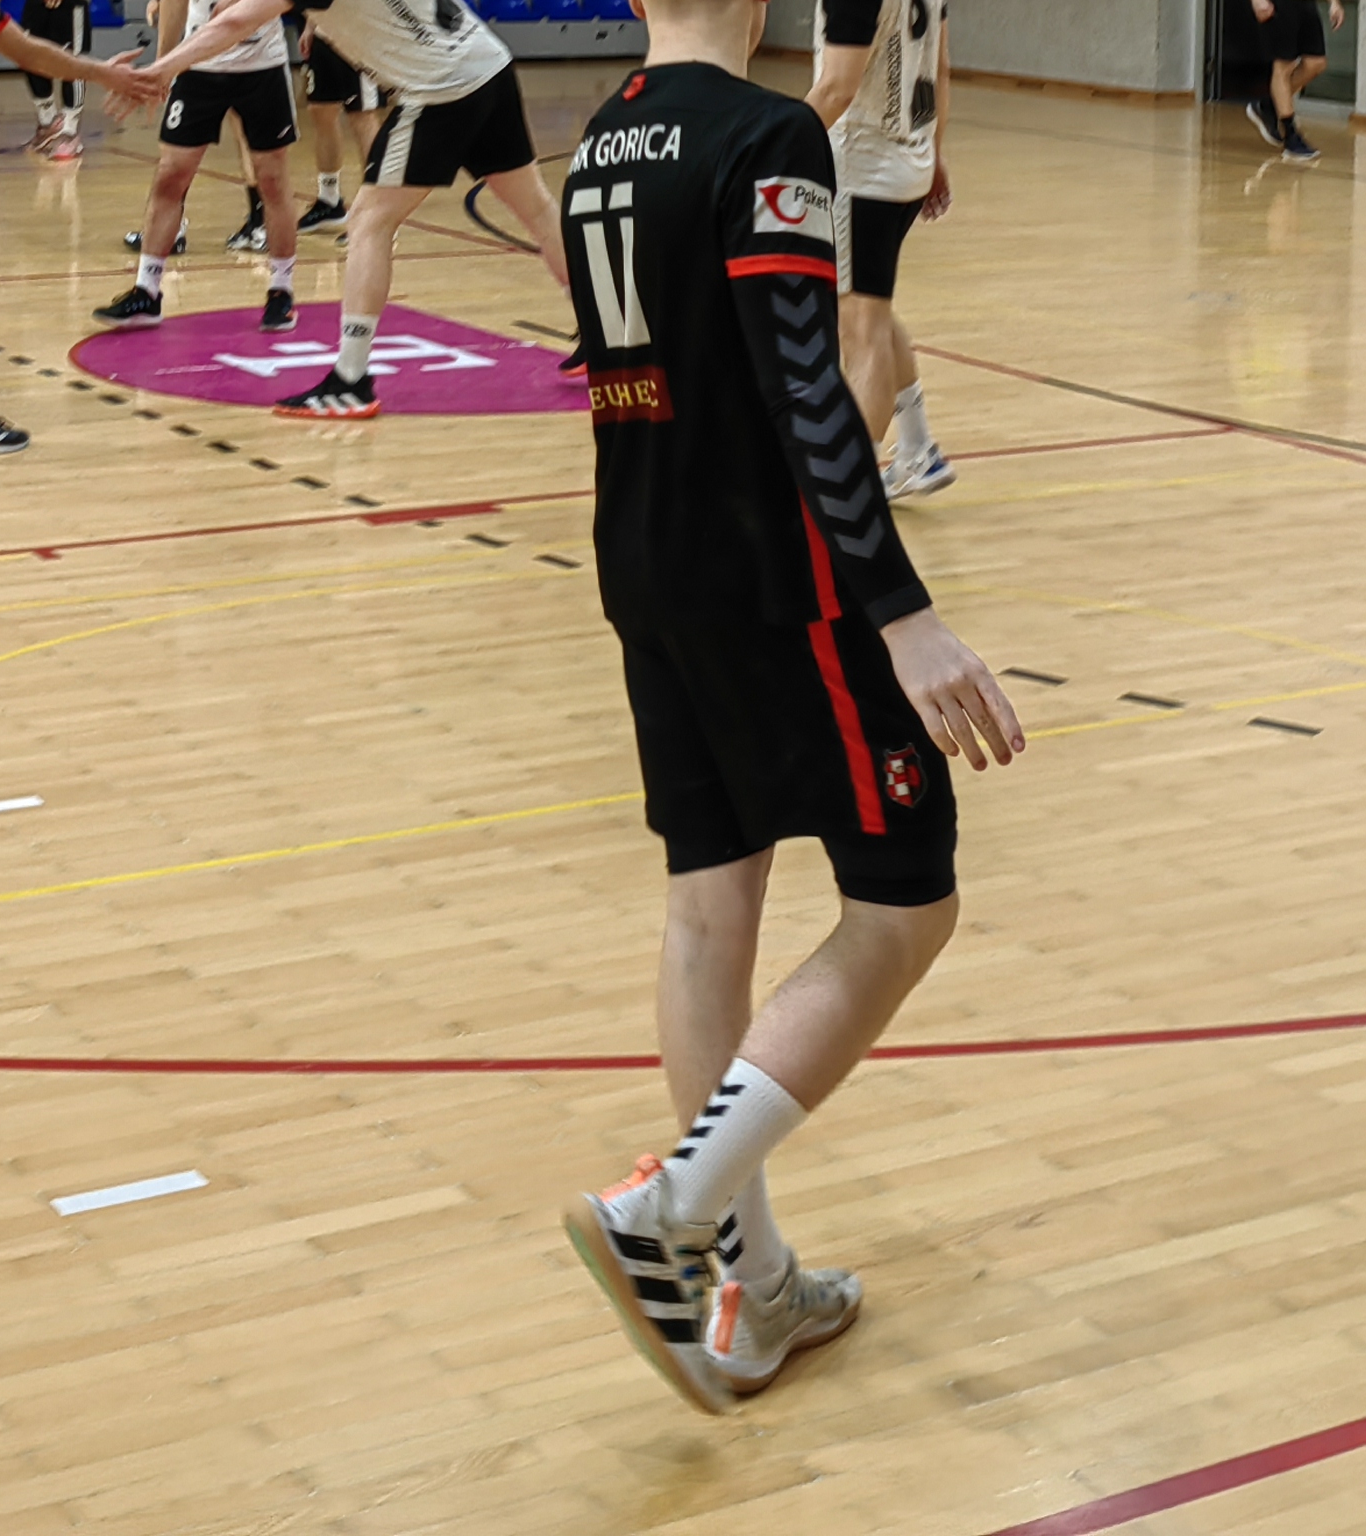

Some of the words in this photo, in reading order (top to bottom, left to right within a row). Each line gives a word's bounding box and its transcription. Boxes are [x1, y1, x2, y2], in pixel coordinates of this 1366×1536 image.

[166, 99, 185, 130] 8
[595, 124, 682, 168] GORICA
[569, 181, 652, 348] 11
